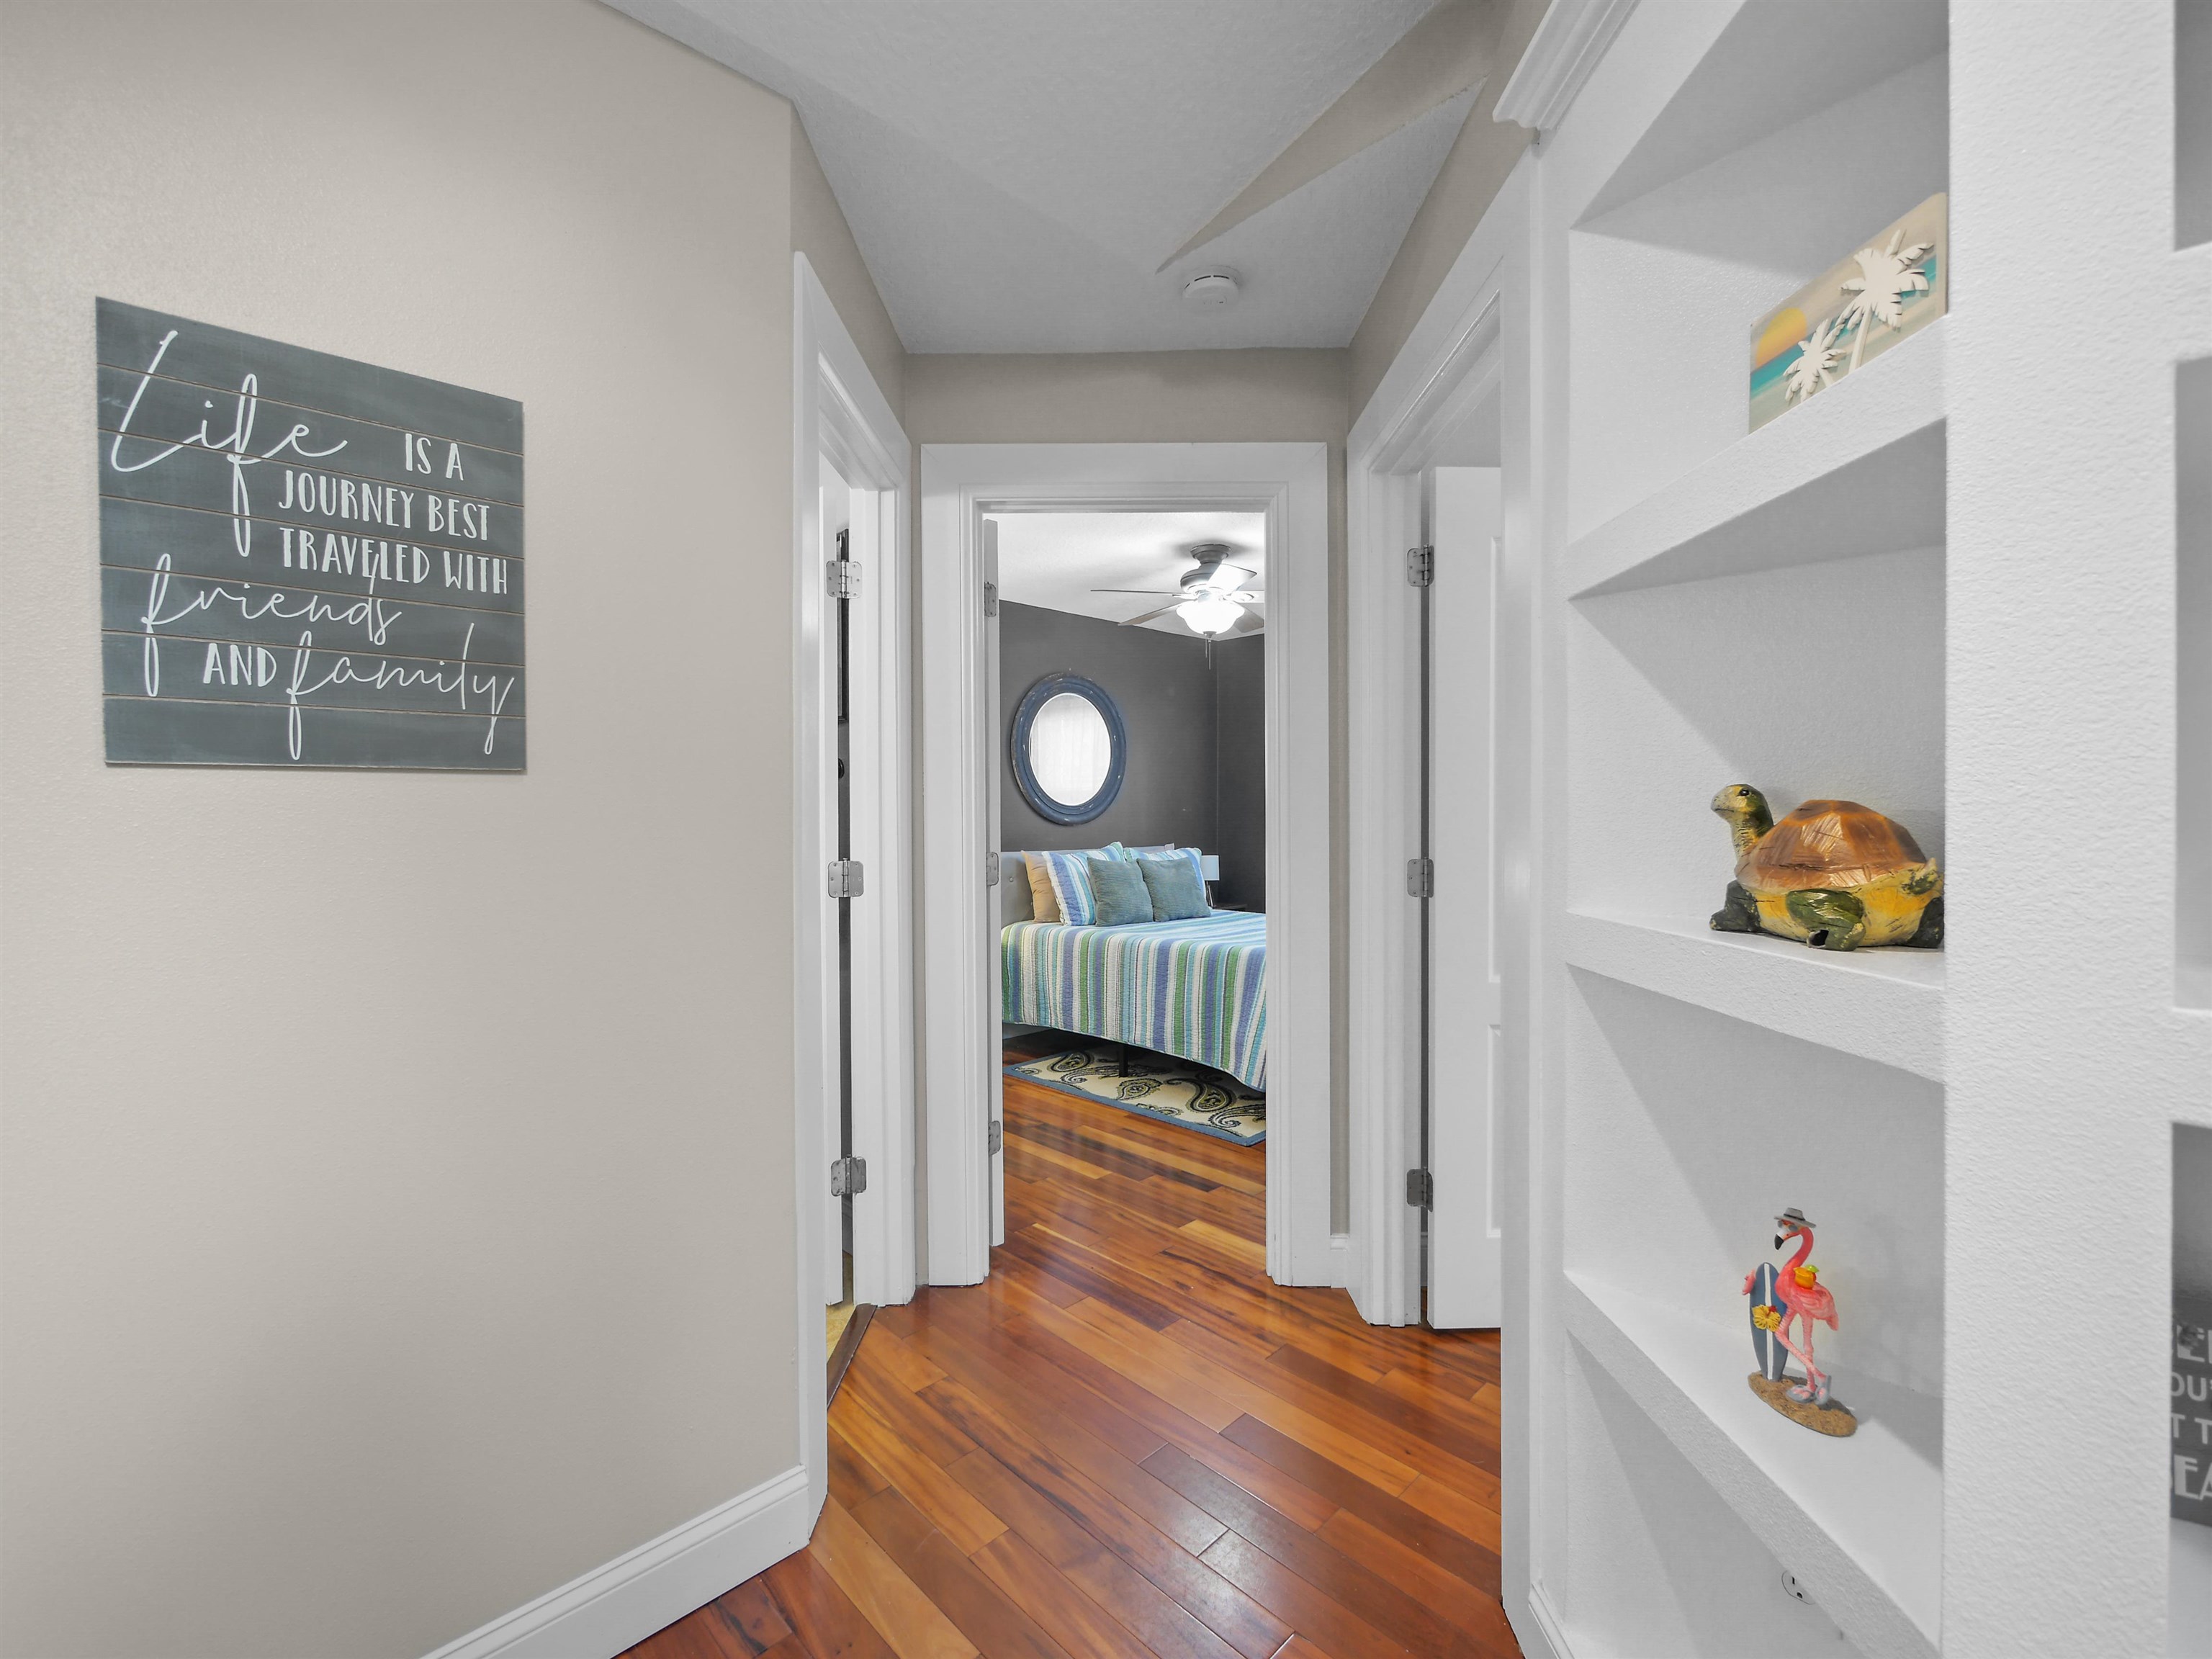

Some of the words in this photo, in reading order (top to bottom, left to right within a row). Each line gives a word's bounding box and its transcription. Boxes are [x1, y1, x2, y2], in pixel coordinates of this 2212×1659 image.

[110, 330, 348, 557] Life
[405, 433, 432, 475] IS
[445, 442, 464, 481] A
[278, 469, 415, 529] JOURNEY
[428, 495, 490, 541] BEST
[140, 552, 403, 697] friends
[279, 527, 430, 584] TRAVELED
[443, 550, 507, 595] WITH
[202, 642, 277, 688] AND
[285, 622, 515, 760] family
